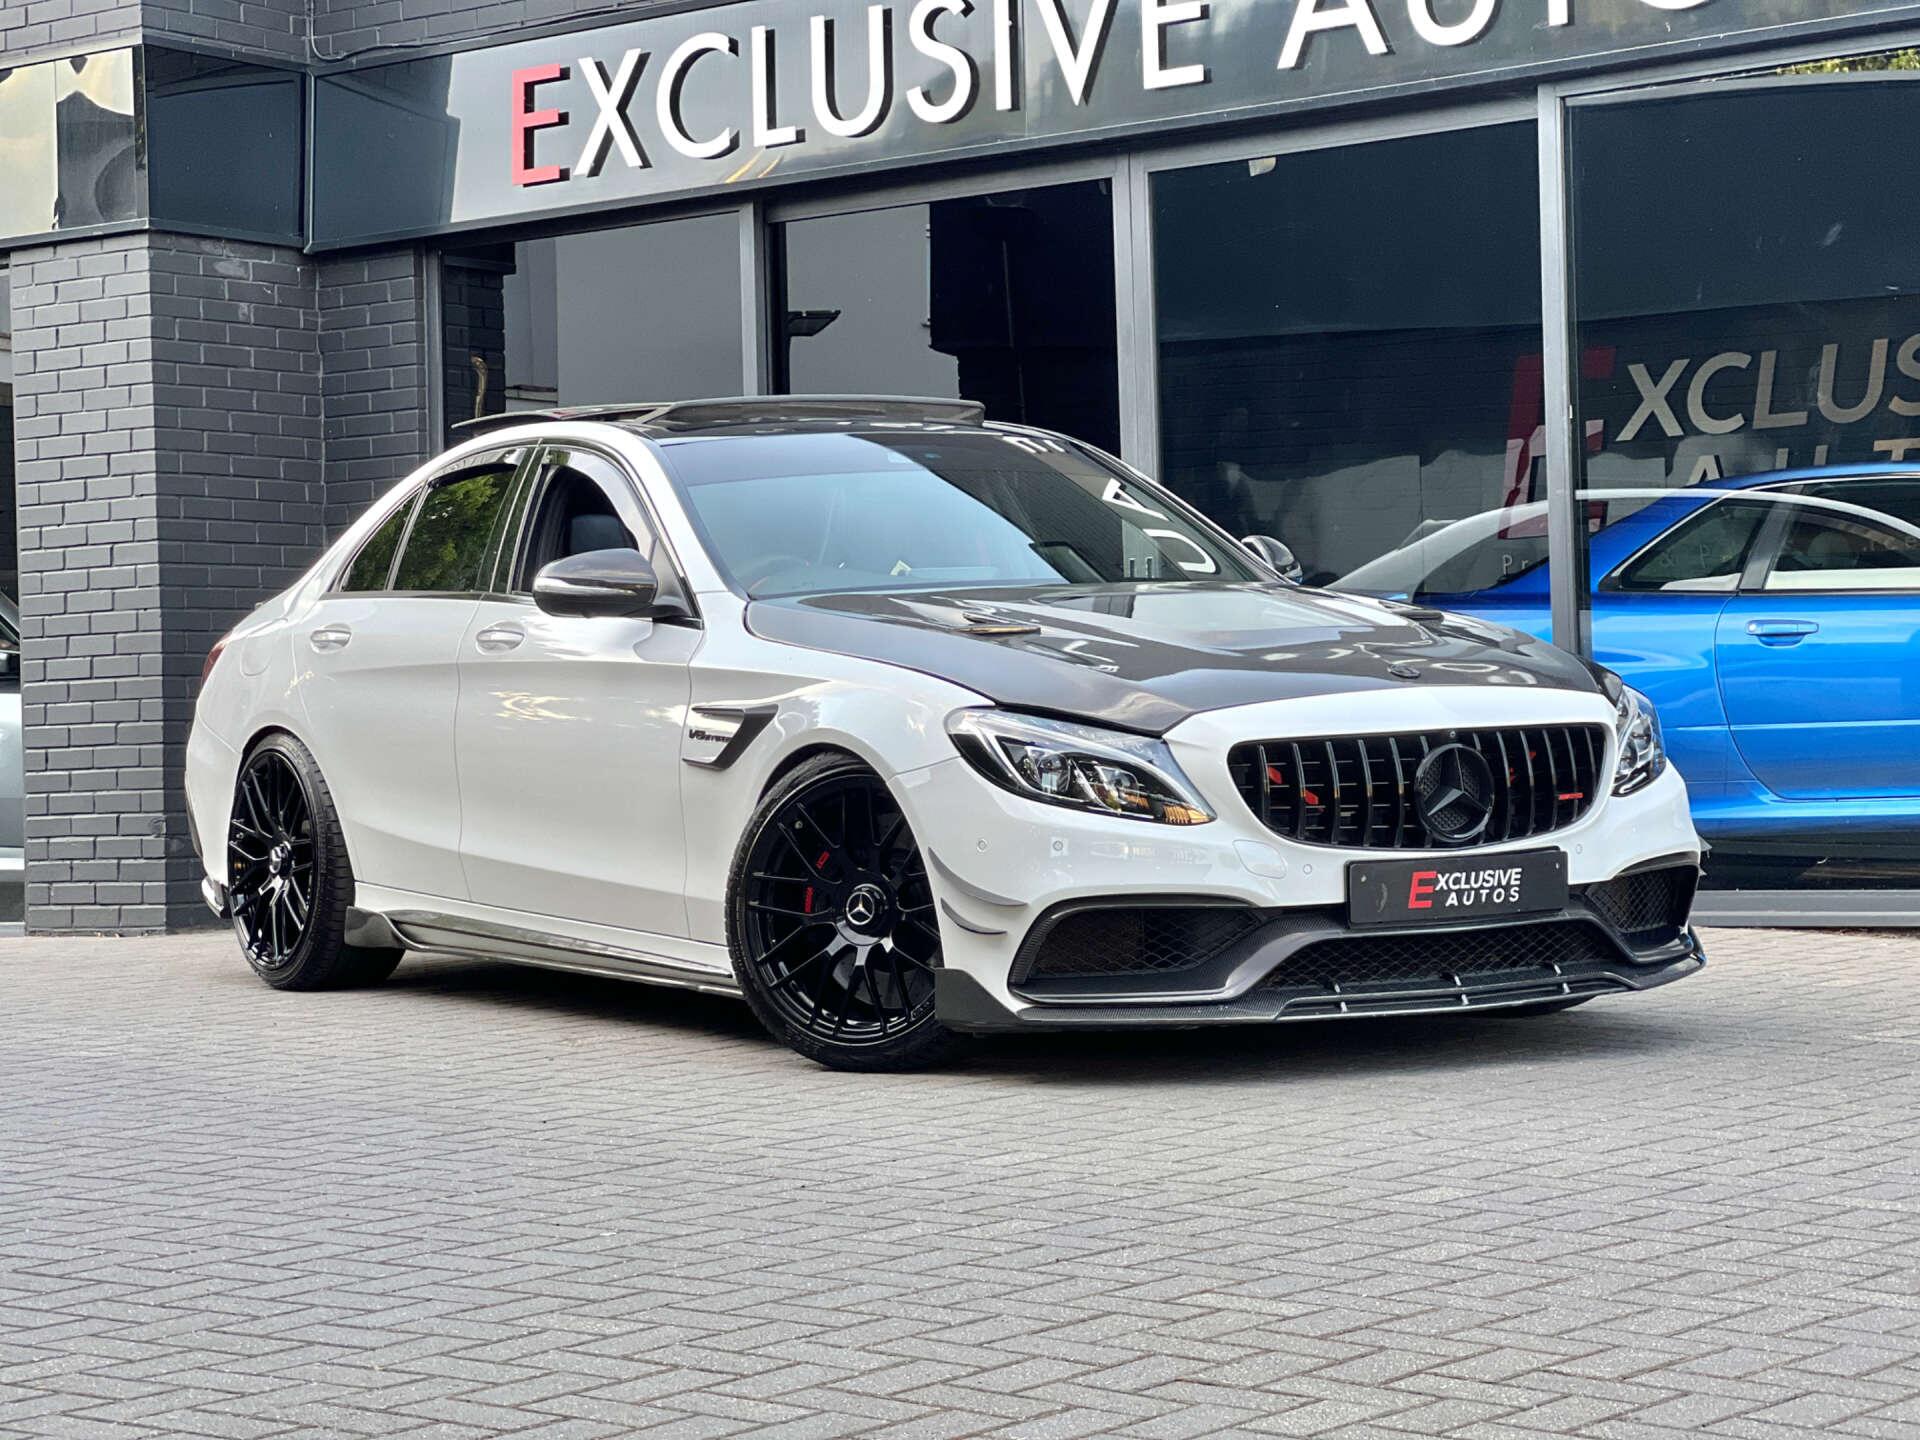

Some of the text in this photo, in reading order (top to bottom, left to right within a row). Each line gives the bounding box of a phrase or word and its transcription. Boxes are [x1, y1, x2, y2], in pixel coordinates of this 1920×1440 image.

[511, 0, 1206, 186] EXCLUSIVE
[1407, 868, 1523, 909] EXCLUSIVE
[1445, 887, 1520, 907] AUTOS
